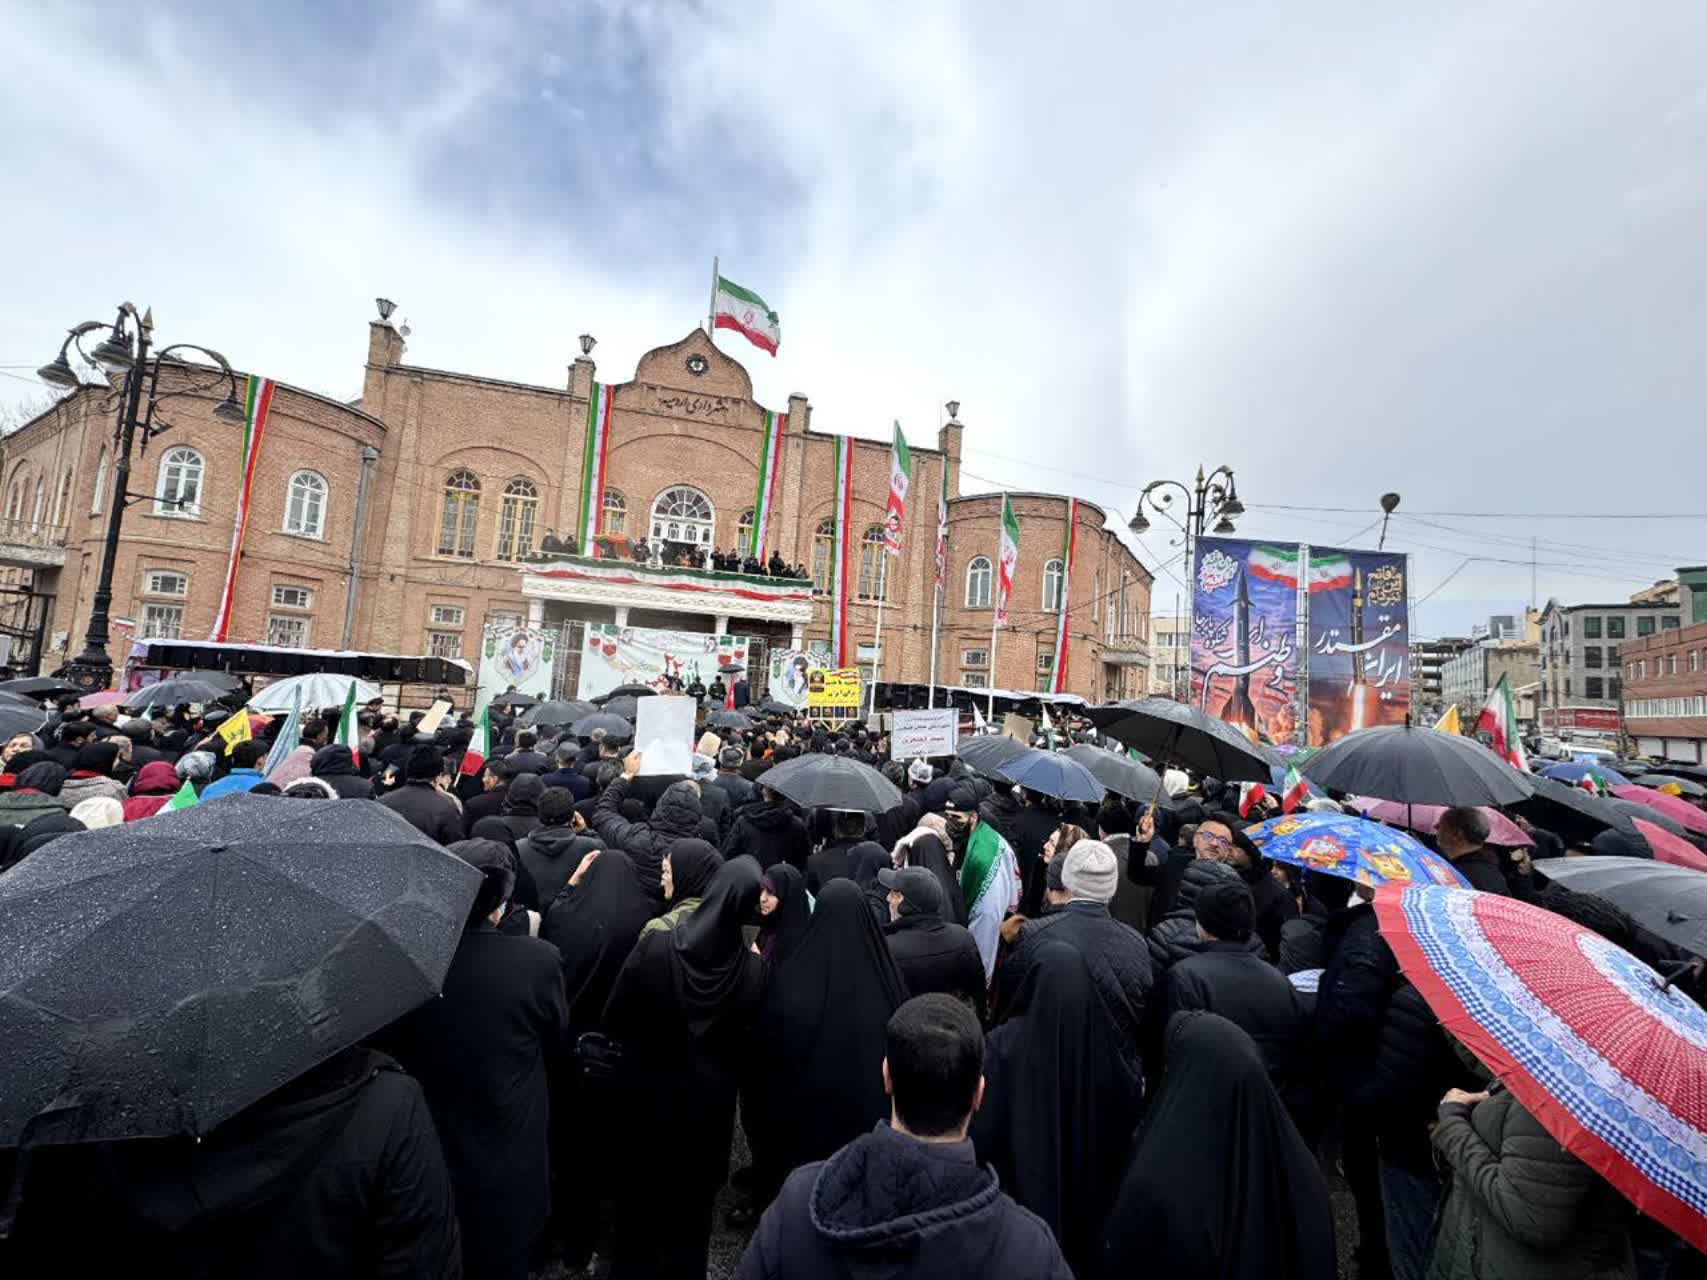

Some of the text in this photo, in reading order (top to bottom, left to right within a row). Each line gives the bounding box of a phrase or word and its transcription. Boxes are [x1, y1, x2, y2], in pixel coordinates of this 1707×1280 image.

[686, 398, 728, 417] شهرداری
[1313, 614, 1402, 654] مقتدر
[1347, 647, 1403, 700] ایران
